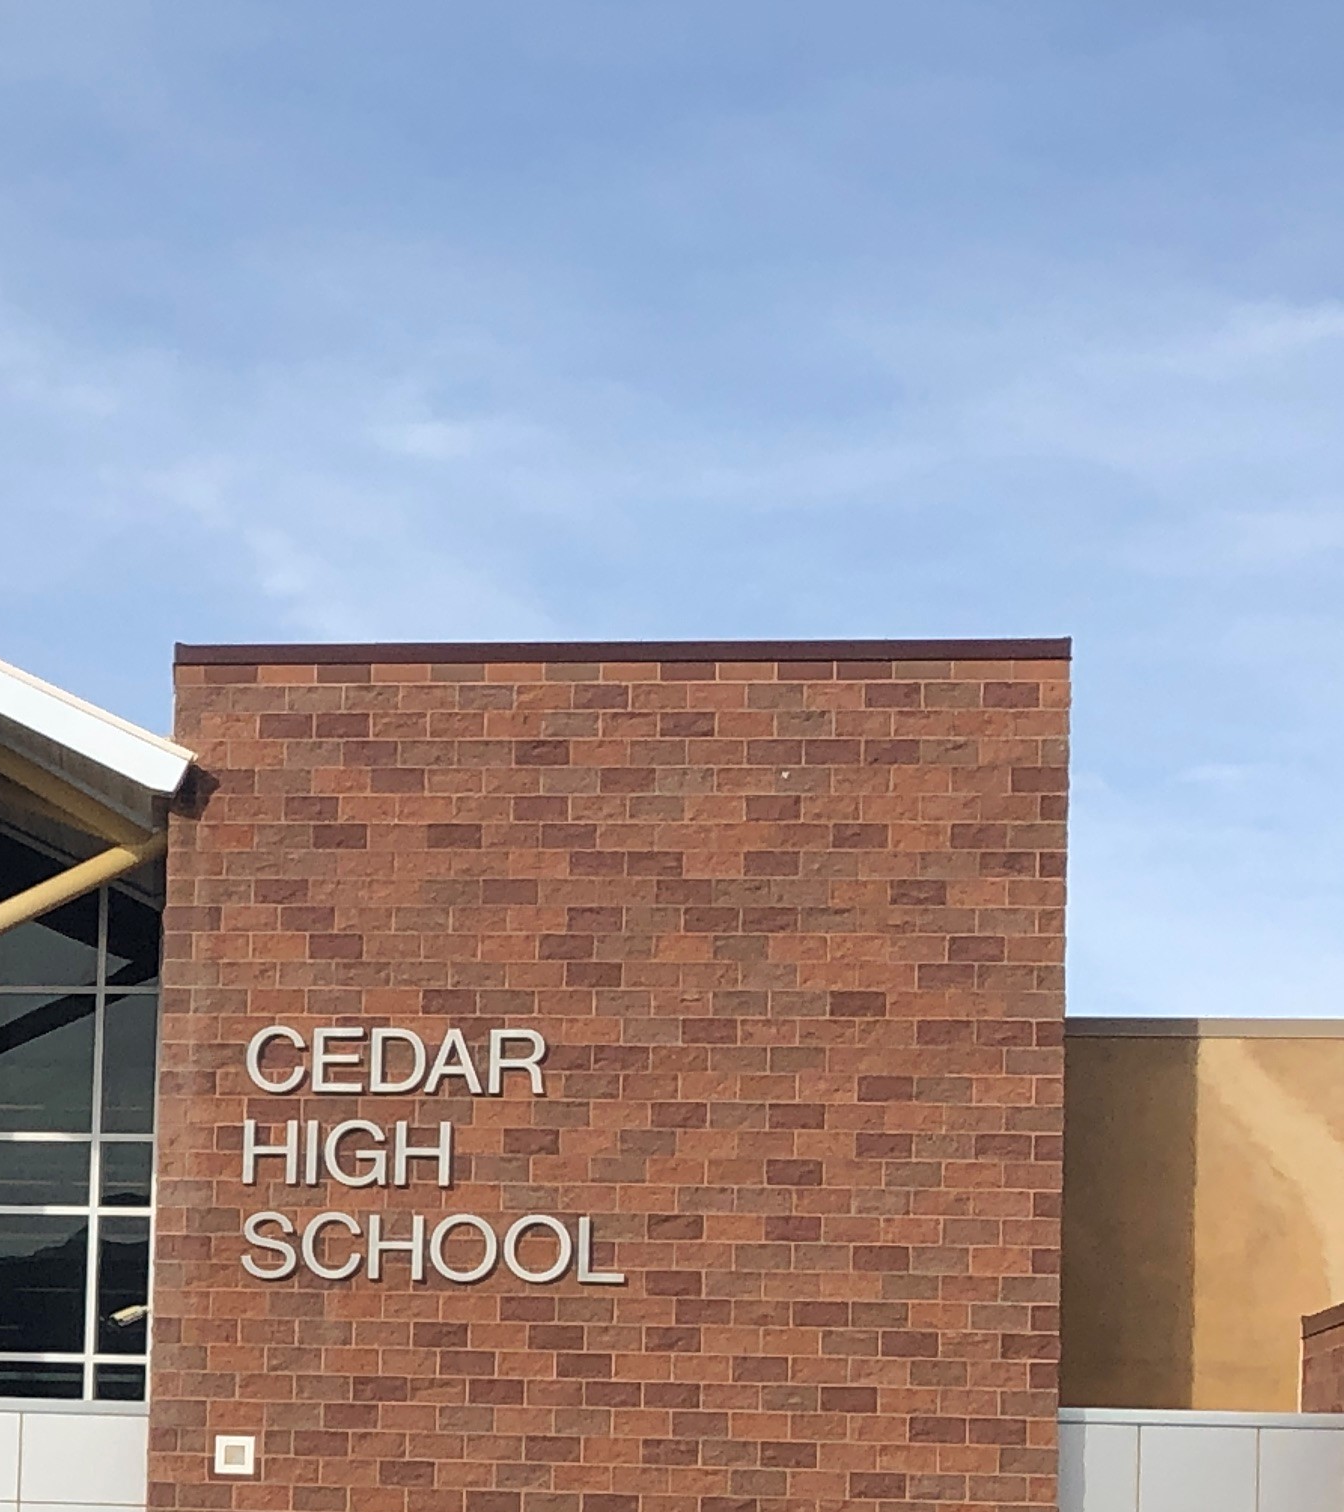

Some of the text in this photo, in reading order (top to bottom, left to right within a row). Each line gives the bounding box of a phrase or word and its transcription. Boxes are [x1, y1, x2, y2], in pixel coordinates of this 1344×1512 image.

[246, 1025, 546, 1095] CEDAR
[242, 1119, 452, 1188] HIGH
[240, 1211, 625, 1284] SCHOOL
